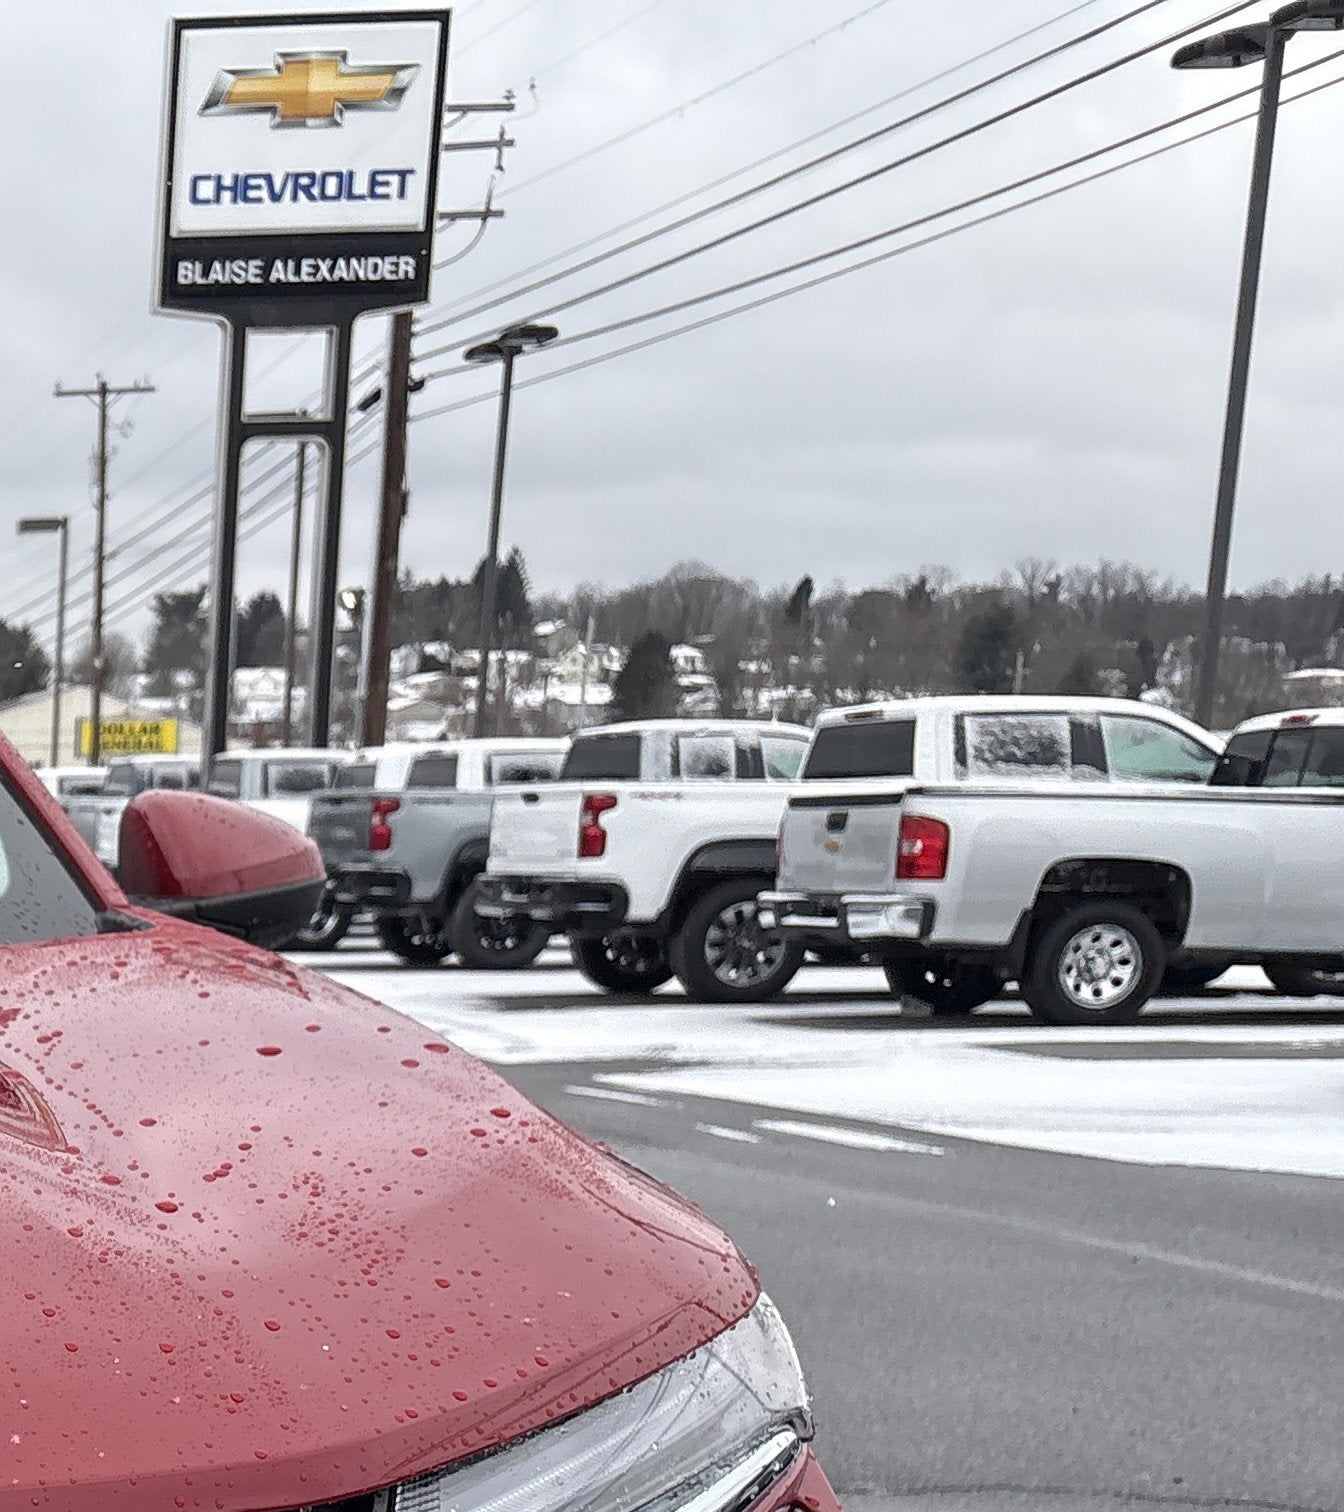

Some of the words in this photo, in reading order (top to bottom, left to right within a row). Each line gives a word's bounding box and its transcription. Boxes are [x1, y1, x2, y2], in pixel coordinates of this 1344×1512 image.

[190, 169, 415, 205] CHEVROLET
[178, 259, 263, 285] BLAISE
[269, 255, 416, 284] ALEXANDER
[100, 738, 163, 751] ENERAL
